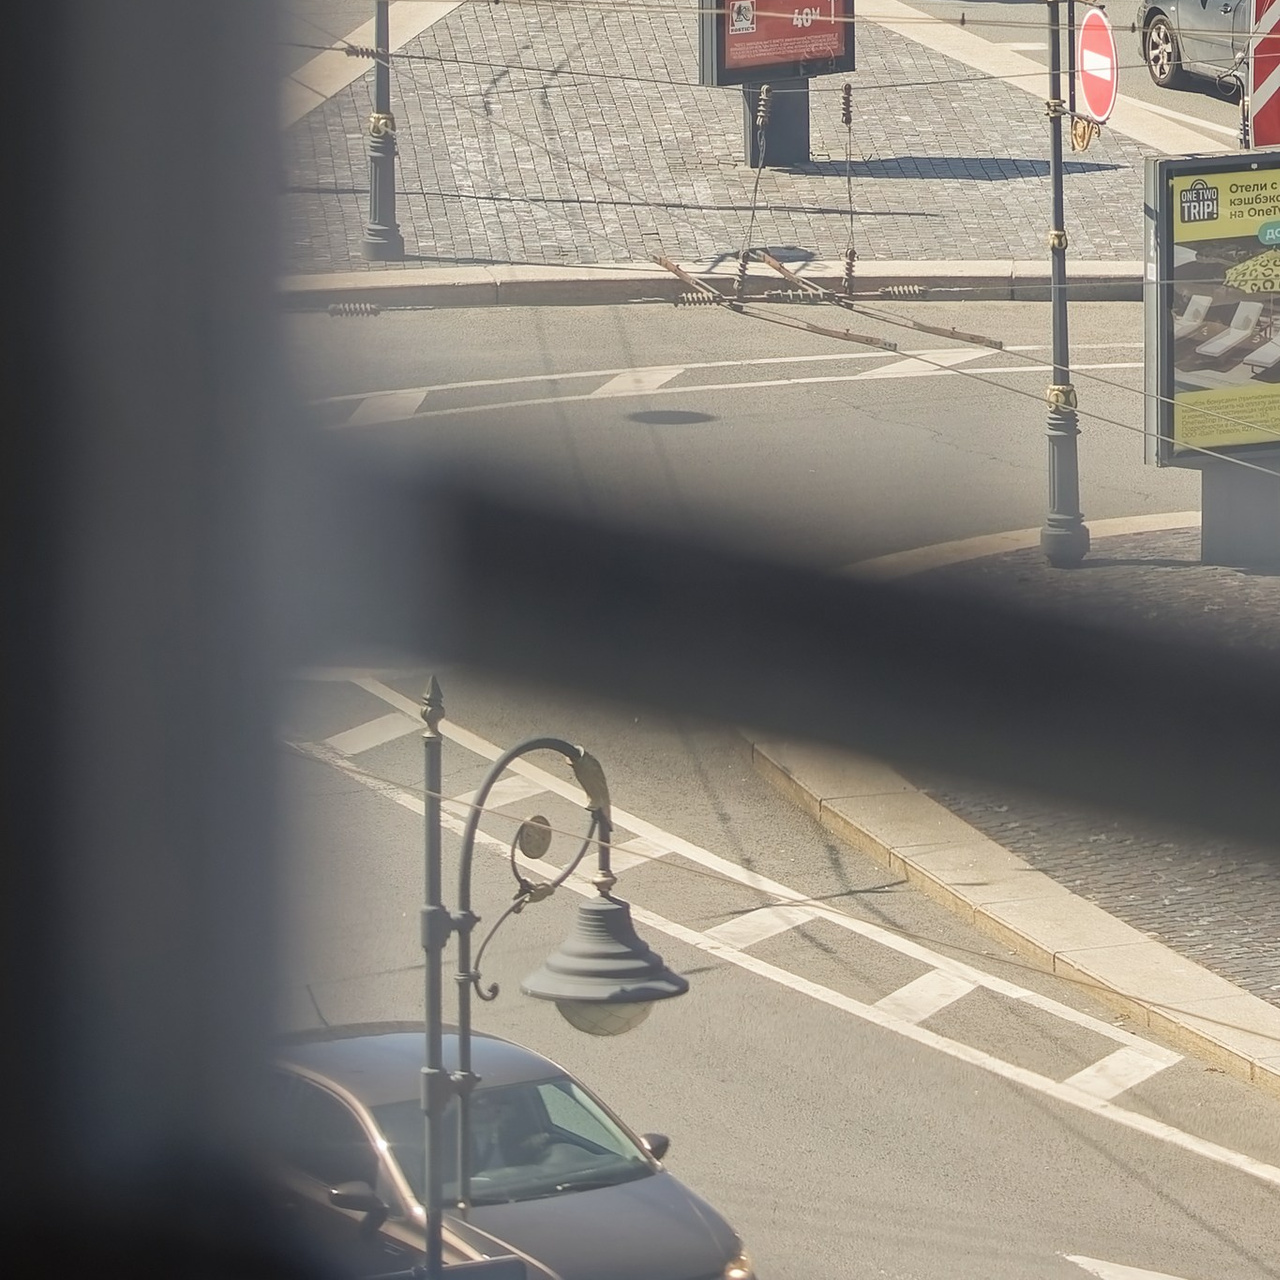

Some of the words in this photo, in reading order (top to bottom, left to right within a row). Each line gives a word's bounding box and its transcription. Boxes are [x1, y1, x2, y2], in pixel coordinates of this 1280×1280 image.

[1229, 183, 1268, 194] Отели
[1270, 181, 1278, 190] с
[1181, 190, 1197, 202] ONE
[1199, 188, 1218, 200] TWO
[1181, 199, 1218, 222] TRIP!
[1229, 209, 1244, 220] на
